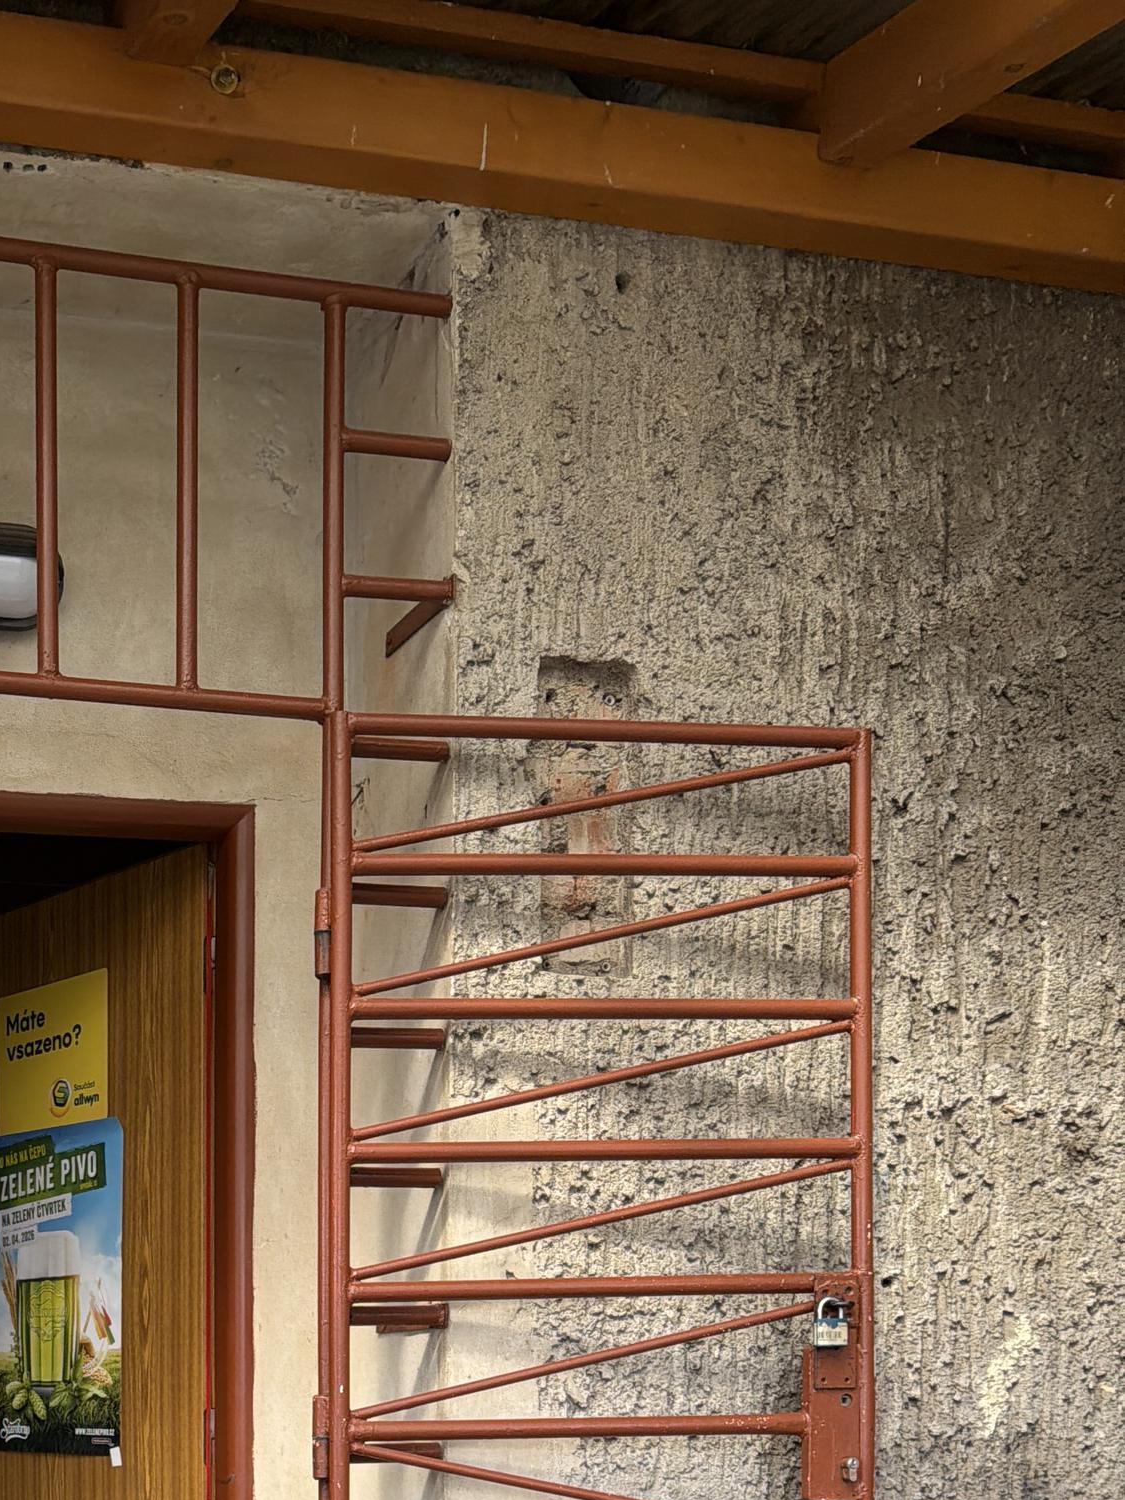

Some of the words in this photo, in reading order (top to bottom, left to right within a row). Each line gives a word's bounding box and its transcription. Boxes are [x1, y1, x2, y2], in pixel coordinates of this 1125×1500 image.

[6, 1009, 45, 1036] Máte
[6, 1024, 81, 1061] vsazeno?
[74, 1093, 99, 1107] allwyn
[5, 1151, 18, 1167] NÁS
[19, 1149, 28, 1163] NA
[0, 1156, 55, 1202] ZELENÉ
[60, 1151, 97, 1186] PIVO
[1, 1213, 11, 1227] NA
[12, 1203, 35, 1225] ZELENÝ
[36, 1198, 67, 1218] ČTVRTEK
